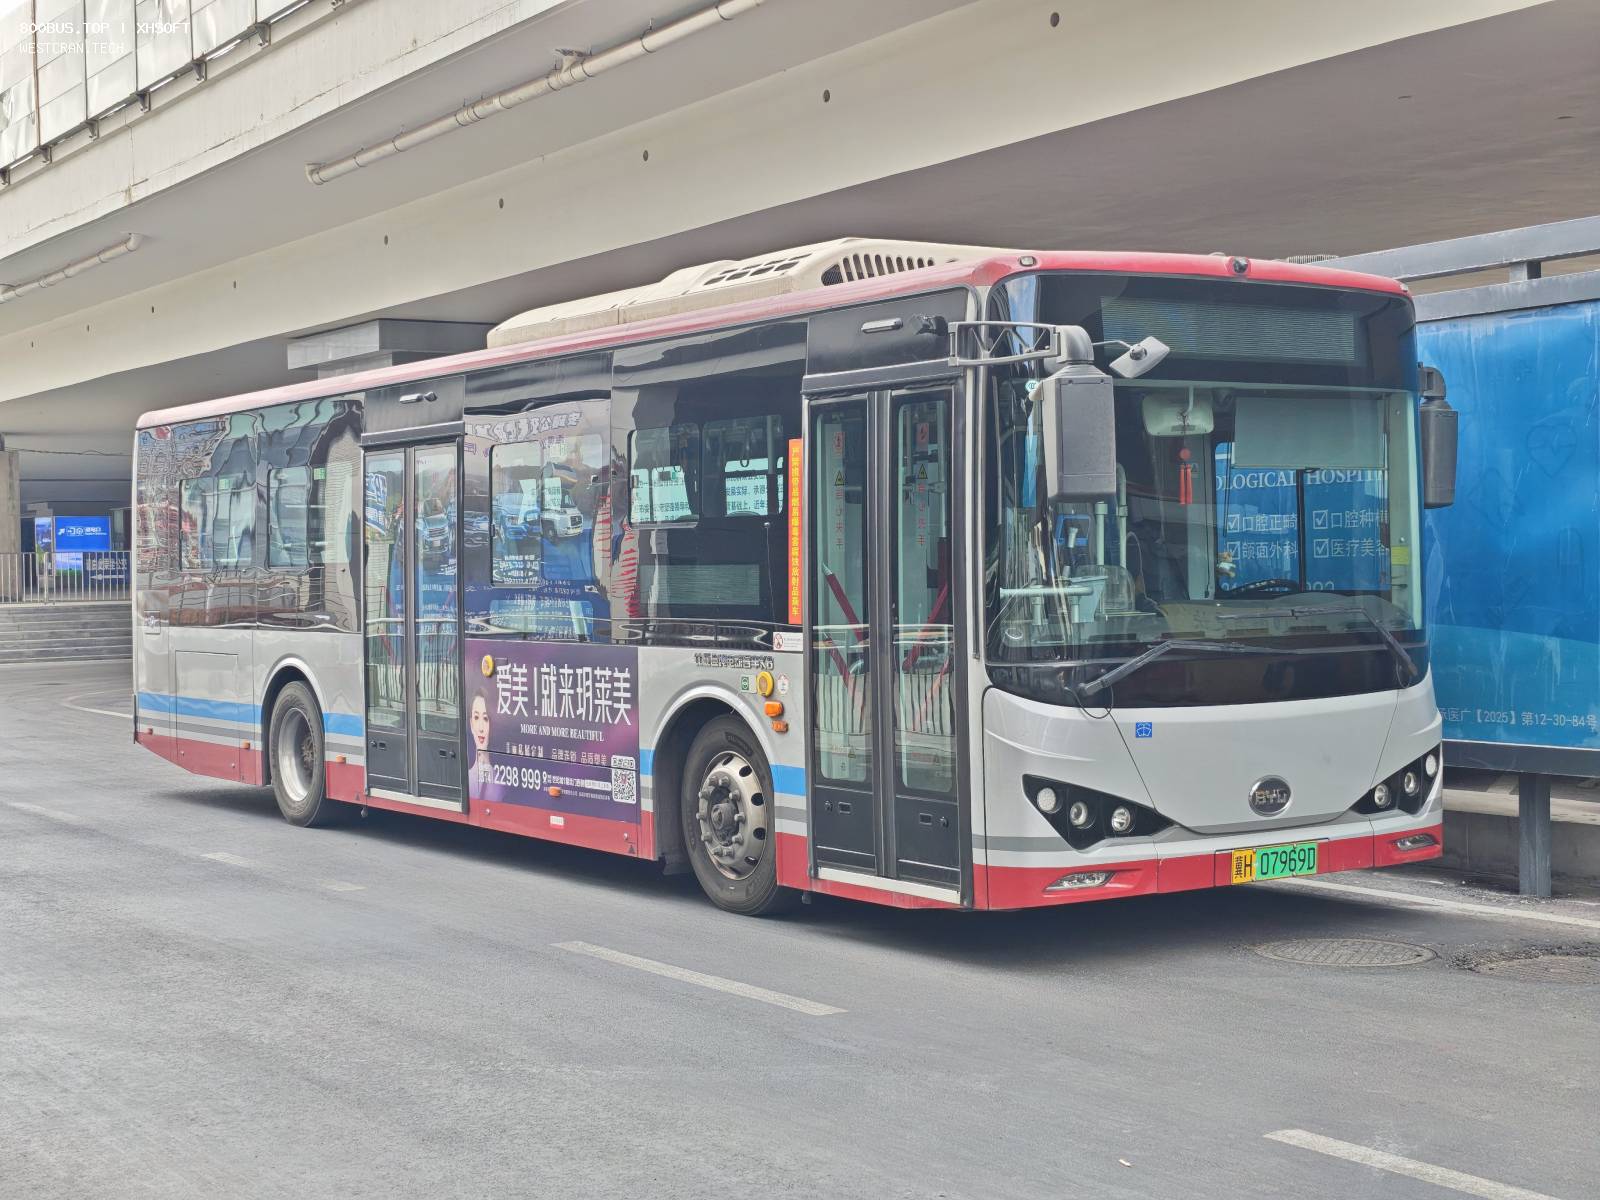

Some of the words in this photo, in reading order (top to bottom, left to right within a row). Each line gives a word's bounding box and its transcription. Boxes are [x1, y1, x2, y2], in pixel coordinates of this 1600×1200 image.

[520, 723, 538, 735] MORE
[539, 725, 551, 737] AND
[551, 727, 570, 739] MORE
[570, 728, 605, 742] BEAUTIFUL
[493, 764, 519, 788] 2298
[521, 767, 541, 791] 999
[1254, 788, 1289, 805] BYD
[1260, 847, 1316, 876] 07969D
